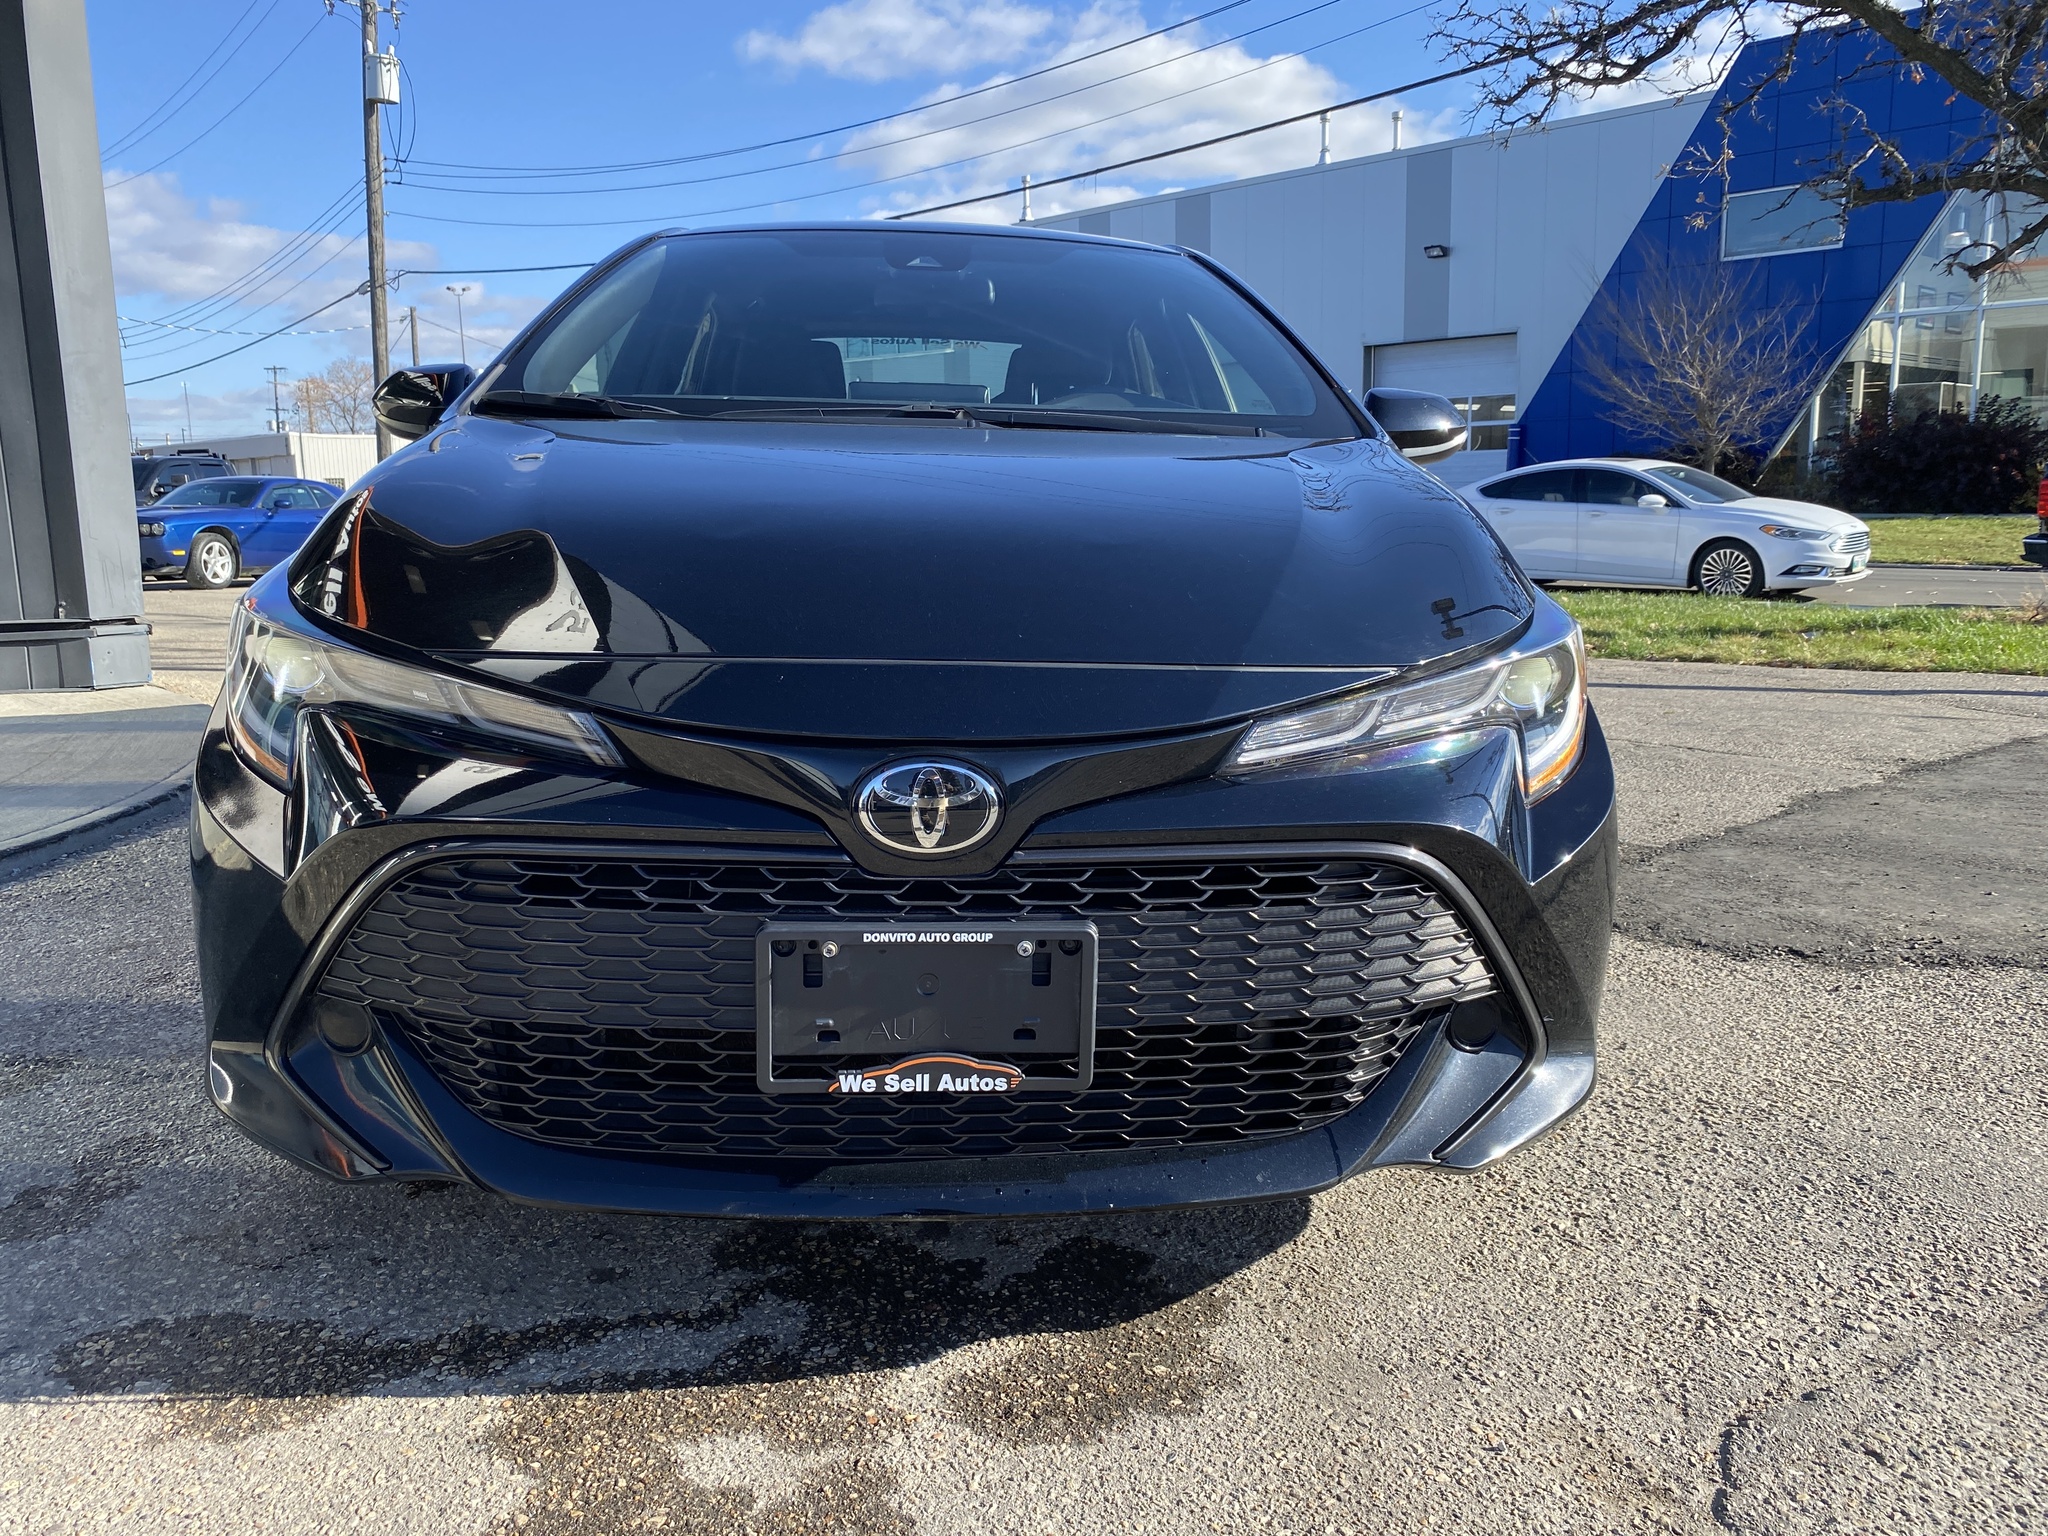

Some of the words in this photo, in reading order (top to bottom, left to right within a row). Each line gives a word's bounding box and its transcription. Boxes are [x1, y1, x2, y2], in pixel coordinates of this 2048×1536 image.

[863, 932, 916, 943] DONVITO
[918, 932, 950, 943] AUTO
[952, 932, 993, 943] GROUP
[838, 1074, 877, 1093] We
[884, 1073, 930, 1092] Sell
[937, 1073, 1008, 1092] Autos
